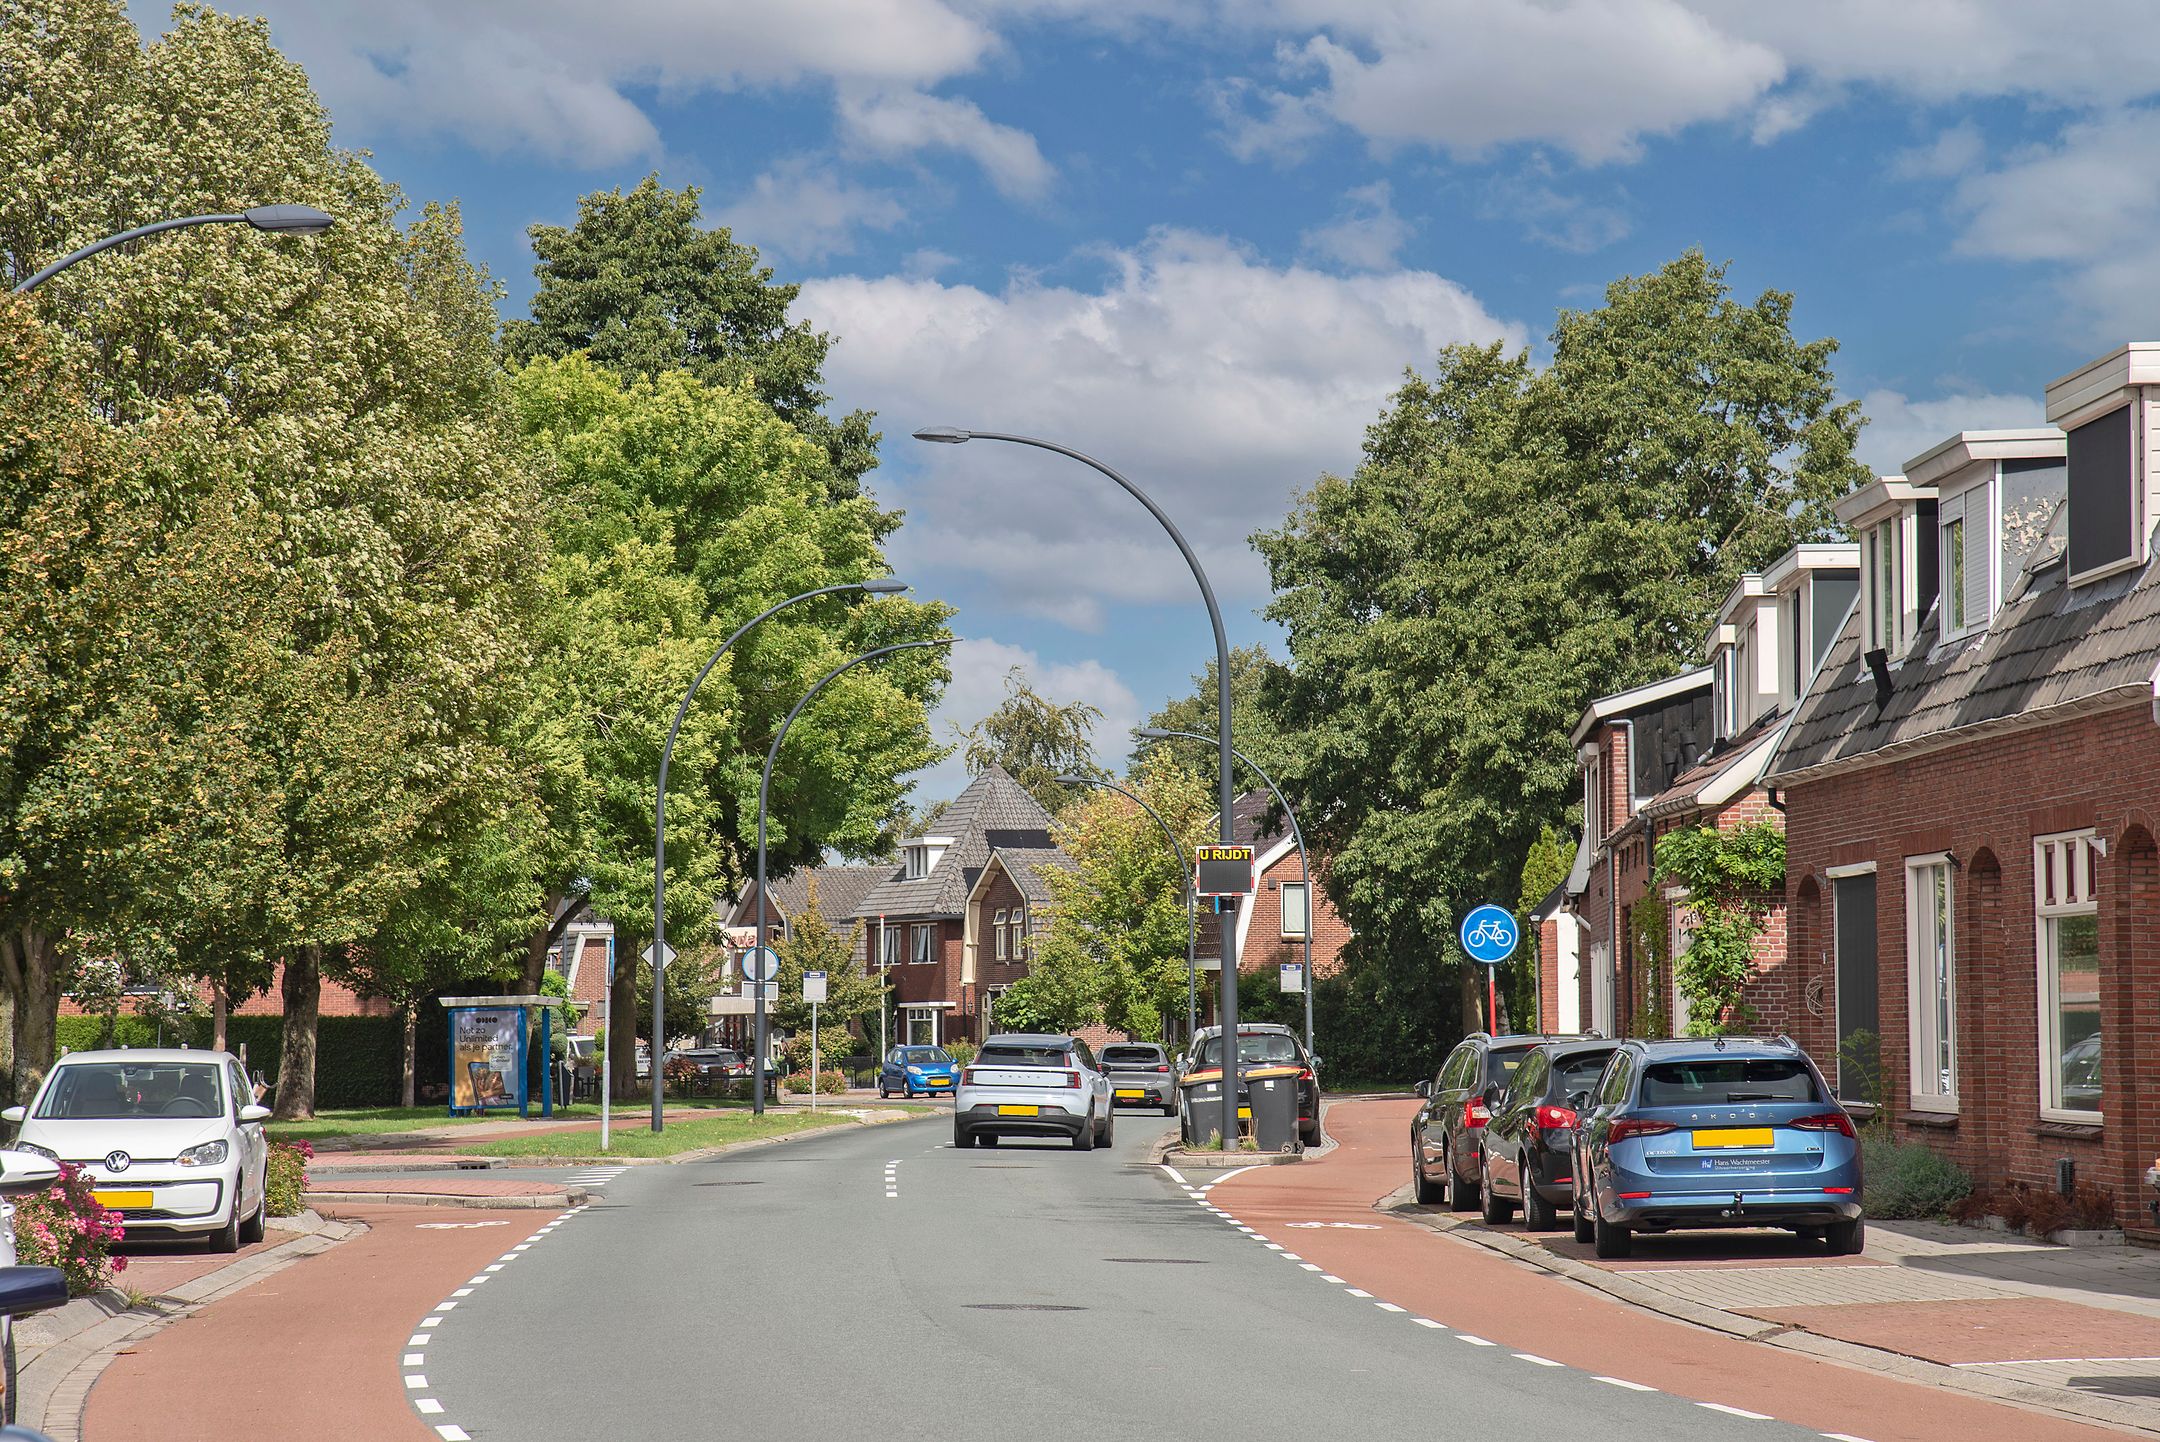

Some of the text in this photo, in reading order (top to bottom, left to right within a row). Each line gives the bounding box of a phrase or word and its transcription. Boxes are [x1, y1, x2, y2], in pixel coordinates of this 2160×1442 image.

[1200, 850, 1250, 860] U RIJDT
[459, 1043, 472, 1051] als
[472, 1043, 481, 1053] je
[1730, 1158, 1770, 1166] Wachtmeester
